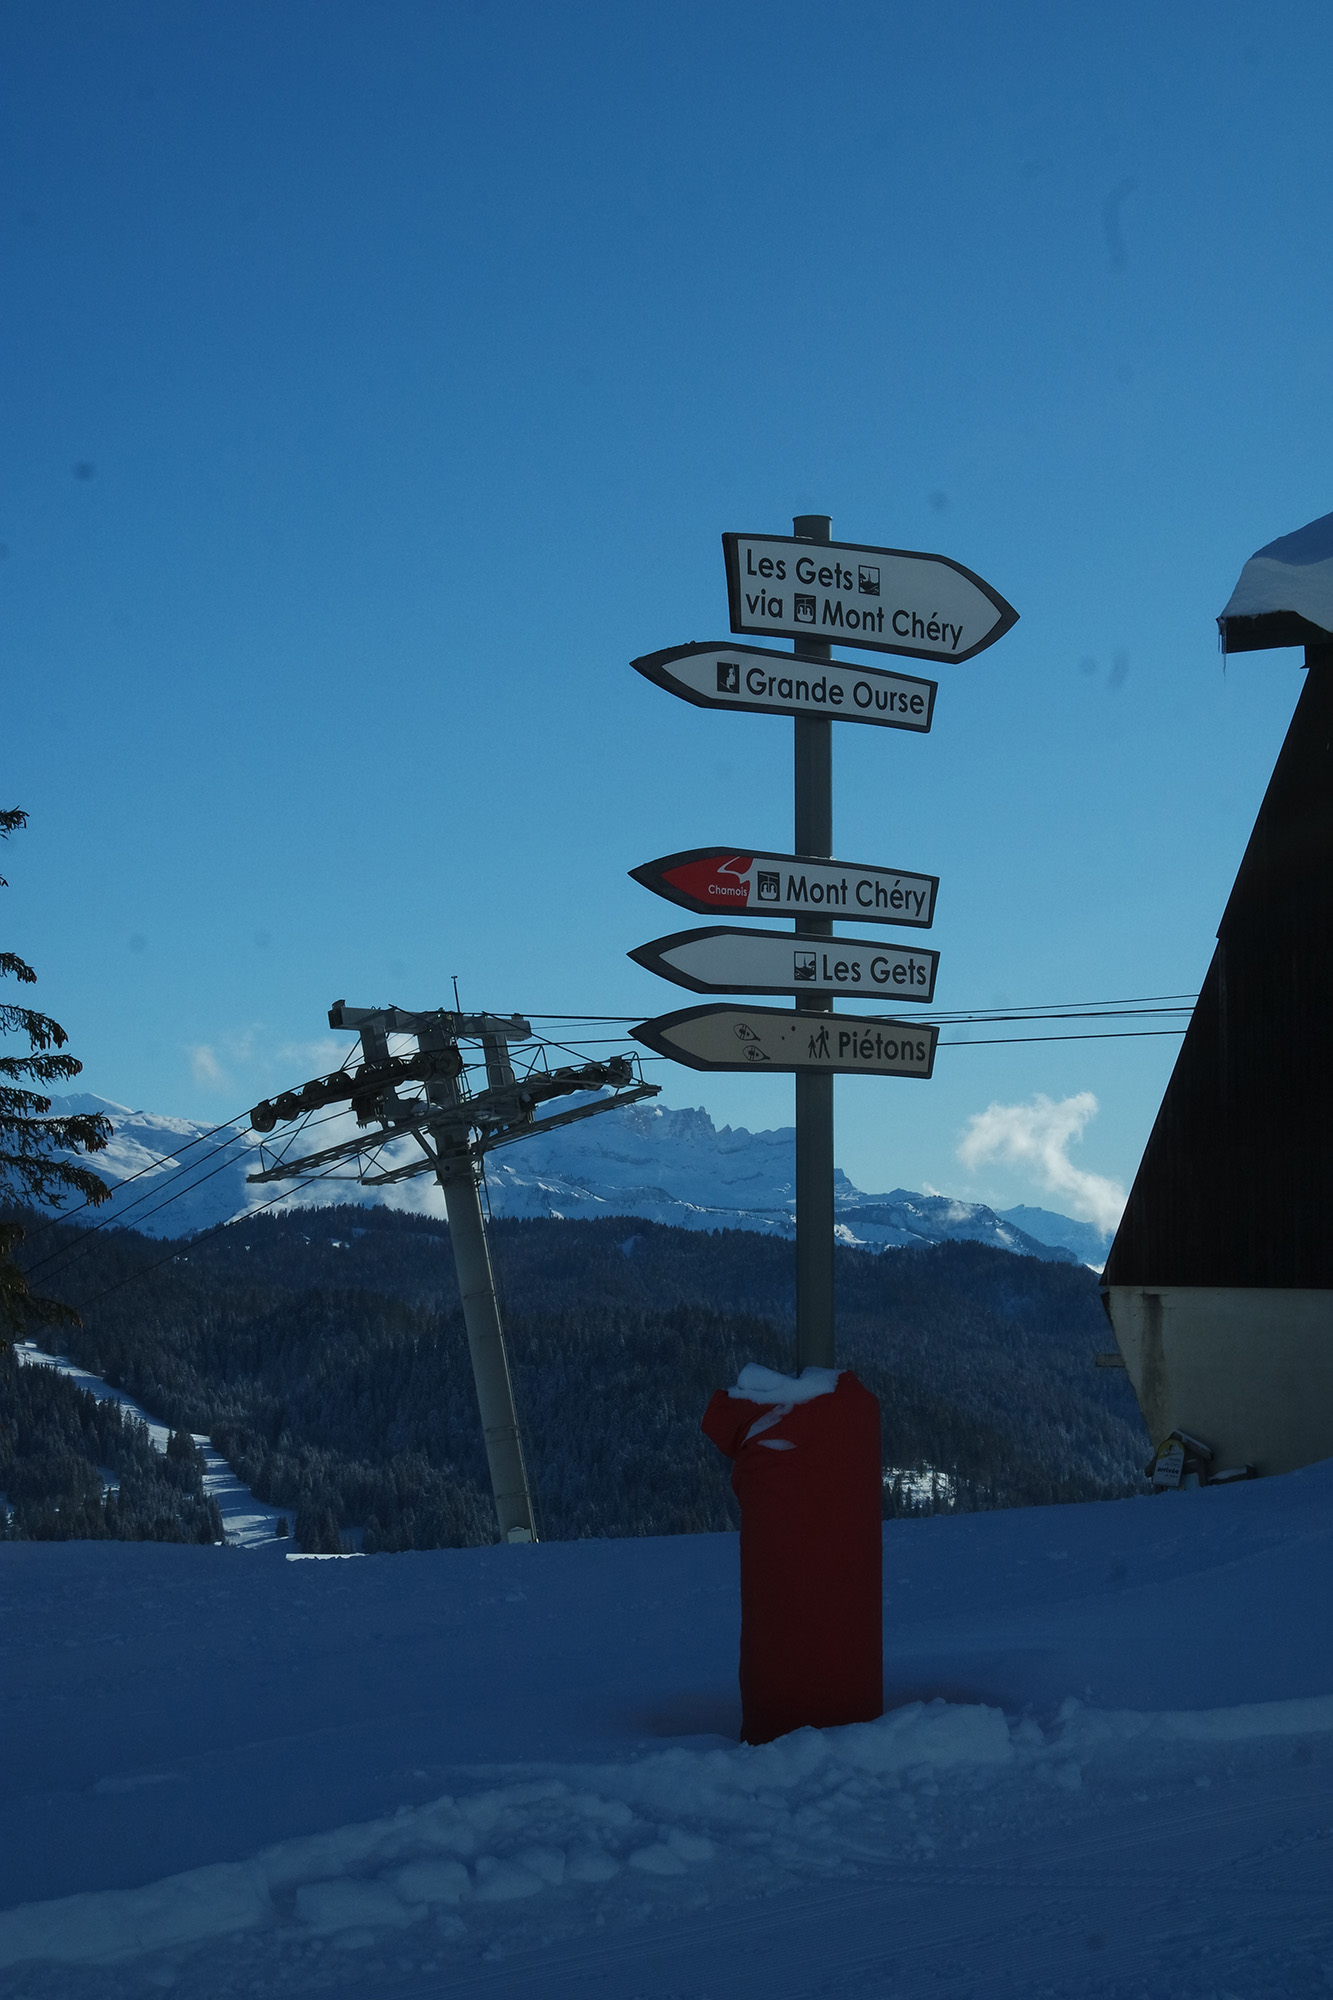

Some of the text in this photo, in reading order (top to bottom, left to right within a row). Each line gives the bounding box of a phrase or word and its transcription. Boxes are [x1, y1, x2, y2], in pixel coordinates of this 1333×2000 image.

[747, 549, 853, 590] Les Gets
[746, 589, 963, 650] via Mont Chéry
[746, 668, 924, 714] Grande Ourse
[708, 884, 748, 897] Chamois
[787, 875, 926, 917] Mont Chéry
[823, 954, 927, 985] Les Gets
[838, 1029, 926, 1062] Piétons
